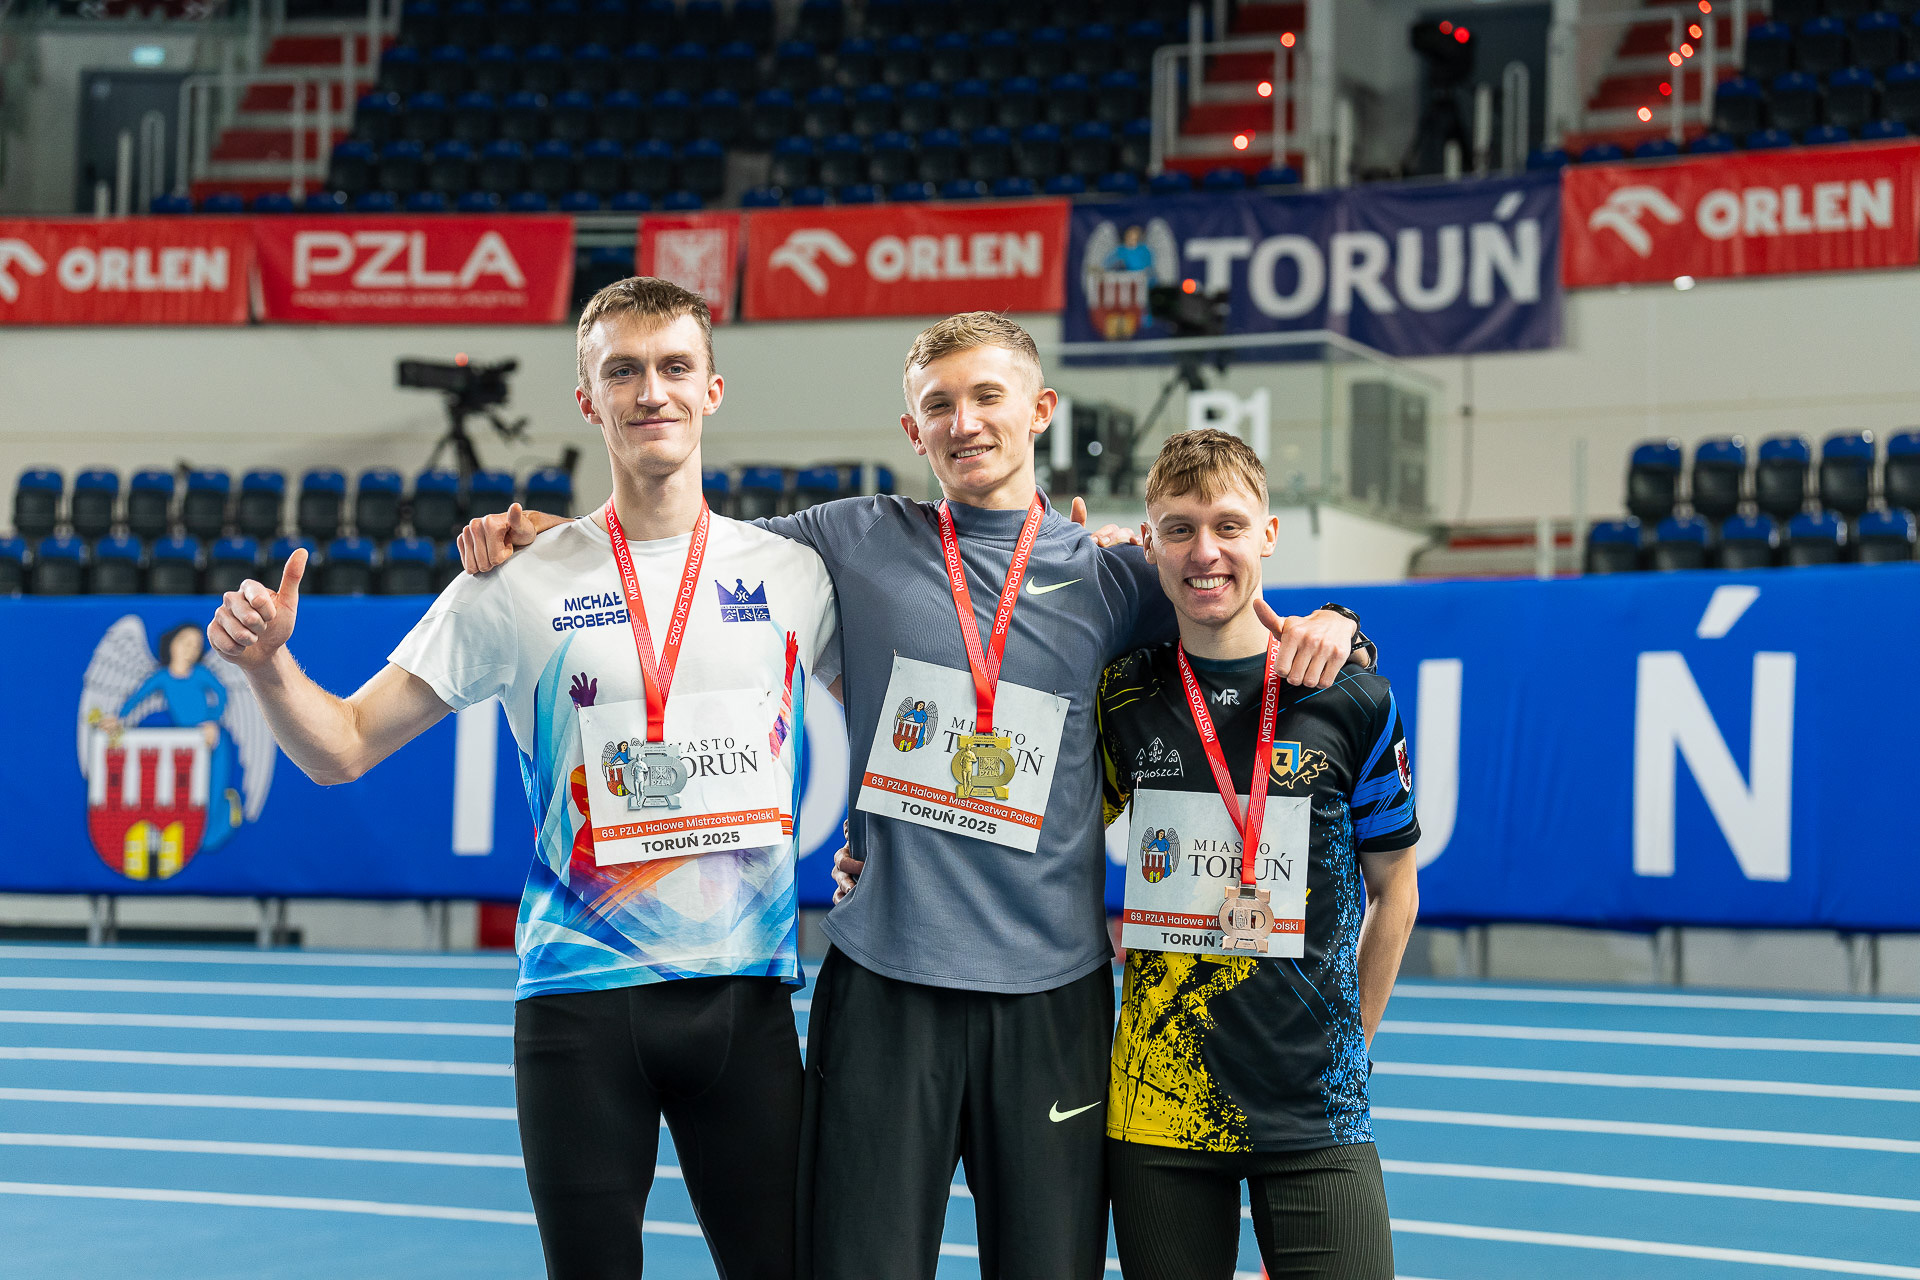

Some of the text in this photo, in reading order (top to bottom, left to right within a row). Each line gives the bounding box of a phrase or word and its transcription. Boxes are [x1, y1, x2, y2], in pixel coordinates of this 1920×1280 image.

[1697, 179, 1895, 240] ORLEN
[57, 247, 230, 291] ORLEN
[293, 231, 525, 289] PZLA
[866, 231, 1043, 283] ORLEN
[1185, 191, 1541, 320] TORUŃ
[611, 529, 640, 600] MISTRZOSTWA
[669, 508, 709, 646] MISTRZOSTWA POLSKI 2025
[941, 523, 965, 592] MISTRZOSTWA
[995, 503, 1042, 635] MISTRZOSTWA POLSKI 2025
[564, 591, 622, 612] MICHAŁ
[1183, 669, 1216, 743] MISTRZOSTWA
[668, 737, 736, 754] ASTO
[679, 745, 758, 779] ORUŃ
[1276, 752, 1288, 767] Z
[871, 776, 1038, 826] 69. PZLA Halowe Mistrzostwa Polski
[901, 801, 997, 835] TORUŃ 2025
[601, 810, 775, 838] 69. PZLA Halowe Mistrzostwa Polski
[641, 831, 741, 853] TORUŃ 2025
[1193, 839, 1271, 855] MIASO
[1130, 912, 1144, 921] 69.
[1145, 914, 1165, 923] PZLA
[1167, 915, 1204, 926] Halowe
[1161, 932, 1215, 947] TORUŃ
